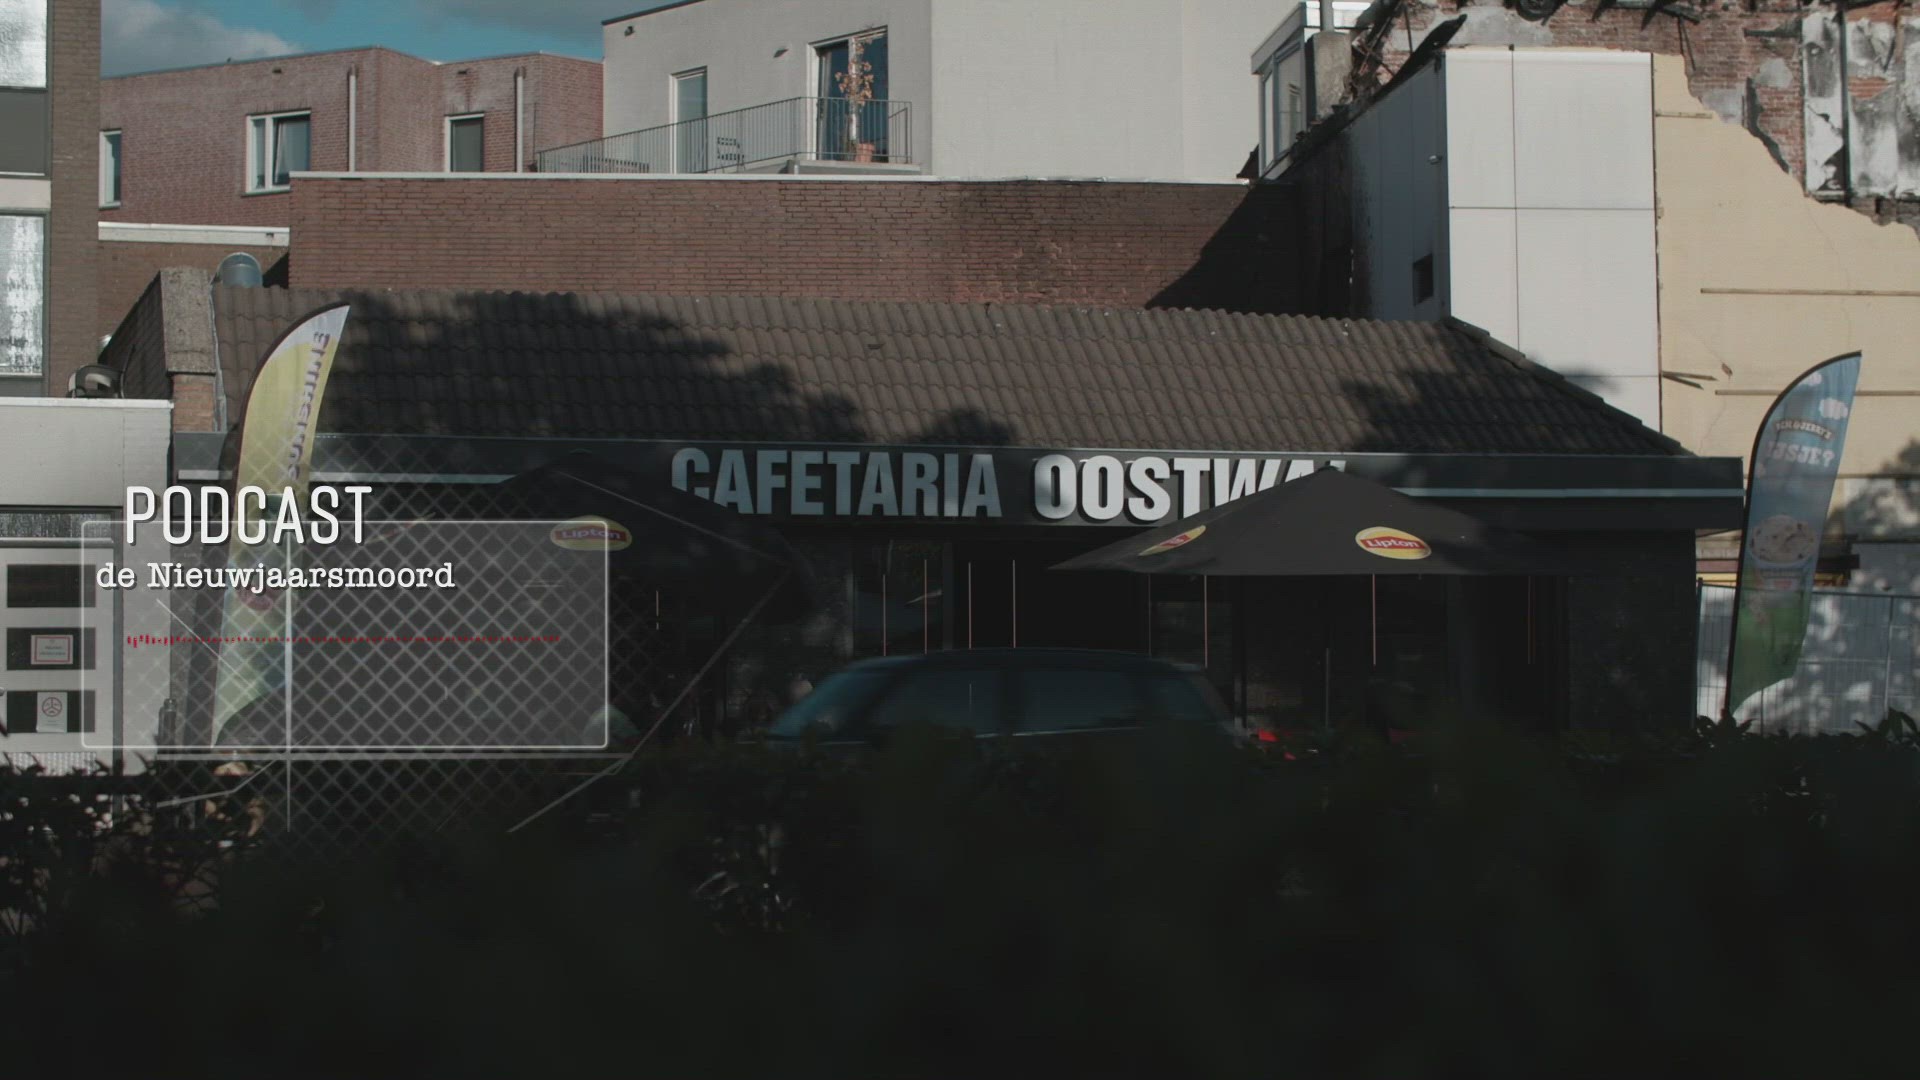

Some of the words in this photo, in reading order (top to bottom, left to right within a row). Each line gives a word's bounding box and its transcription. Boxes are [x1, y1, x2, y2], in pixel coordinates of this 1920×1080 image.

[287, 331, 331, 481] SUNSHINE
[671, 447, 1003, 518] CAFETARIA
[1034, 454, 1346, 521] OOSTW
[562, 528, 620, 539] Lipton
[1366, 539, 1421, 549] Lipton
